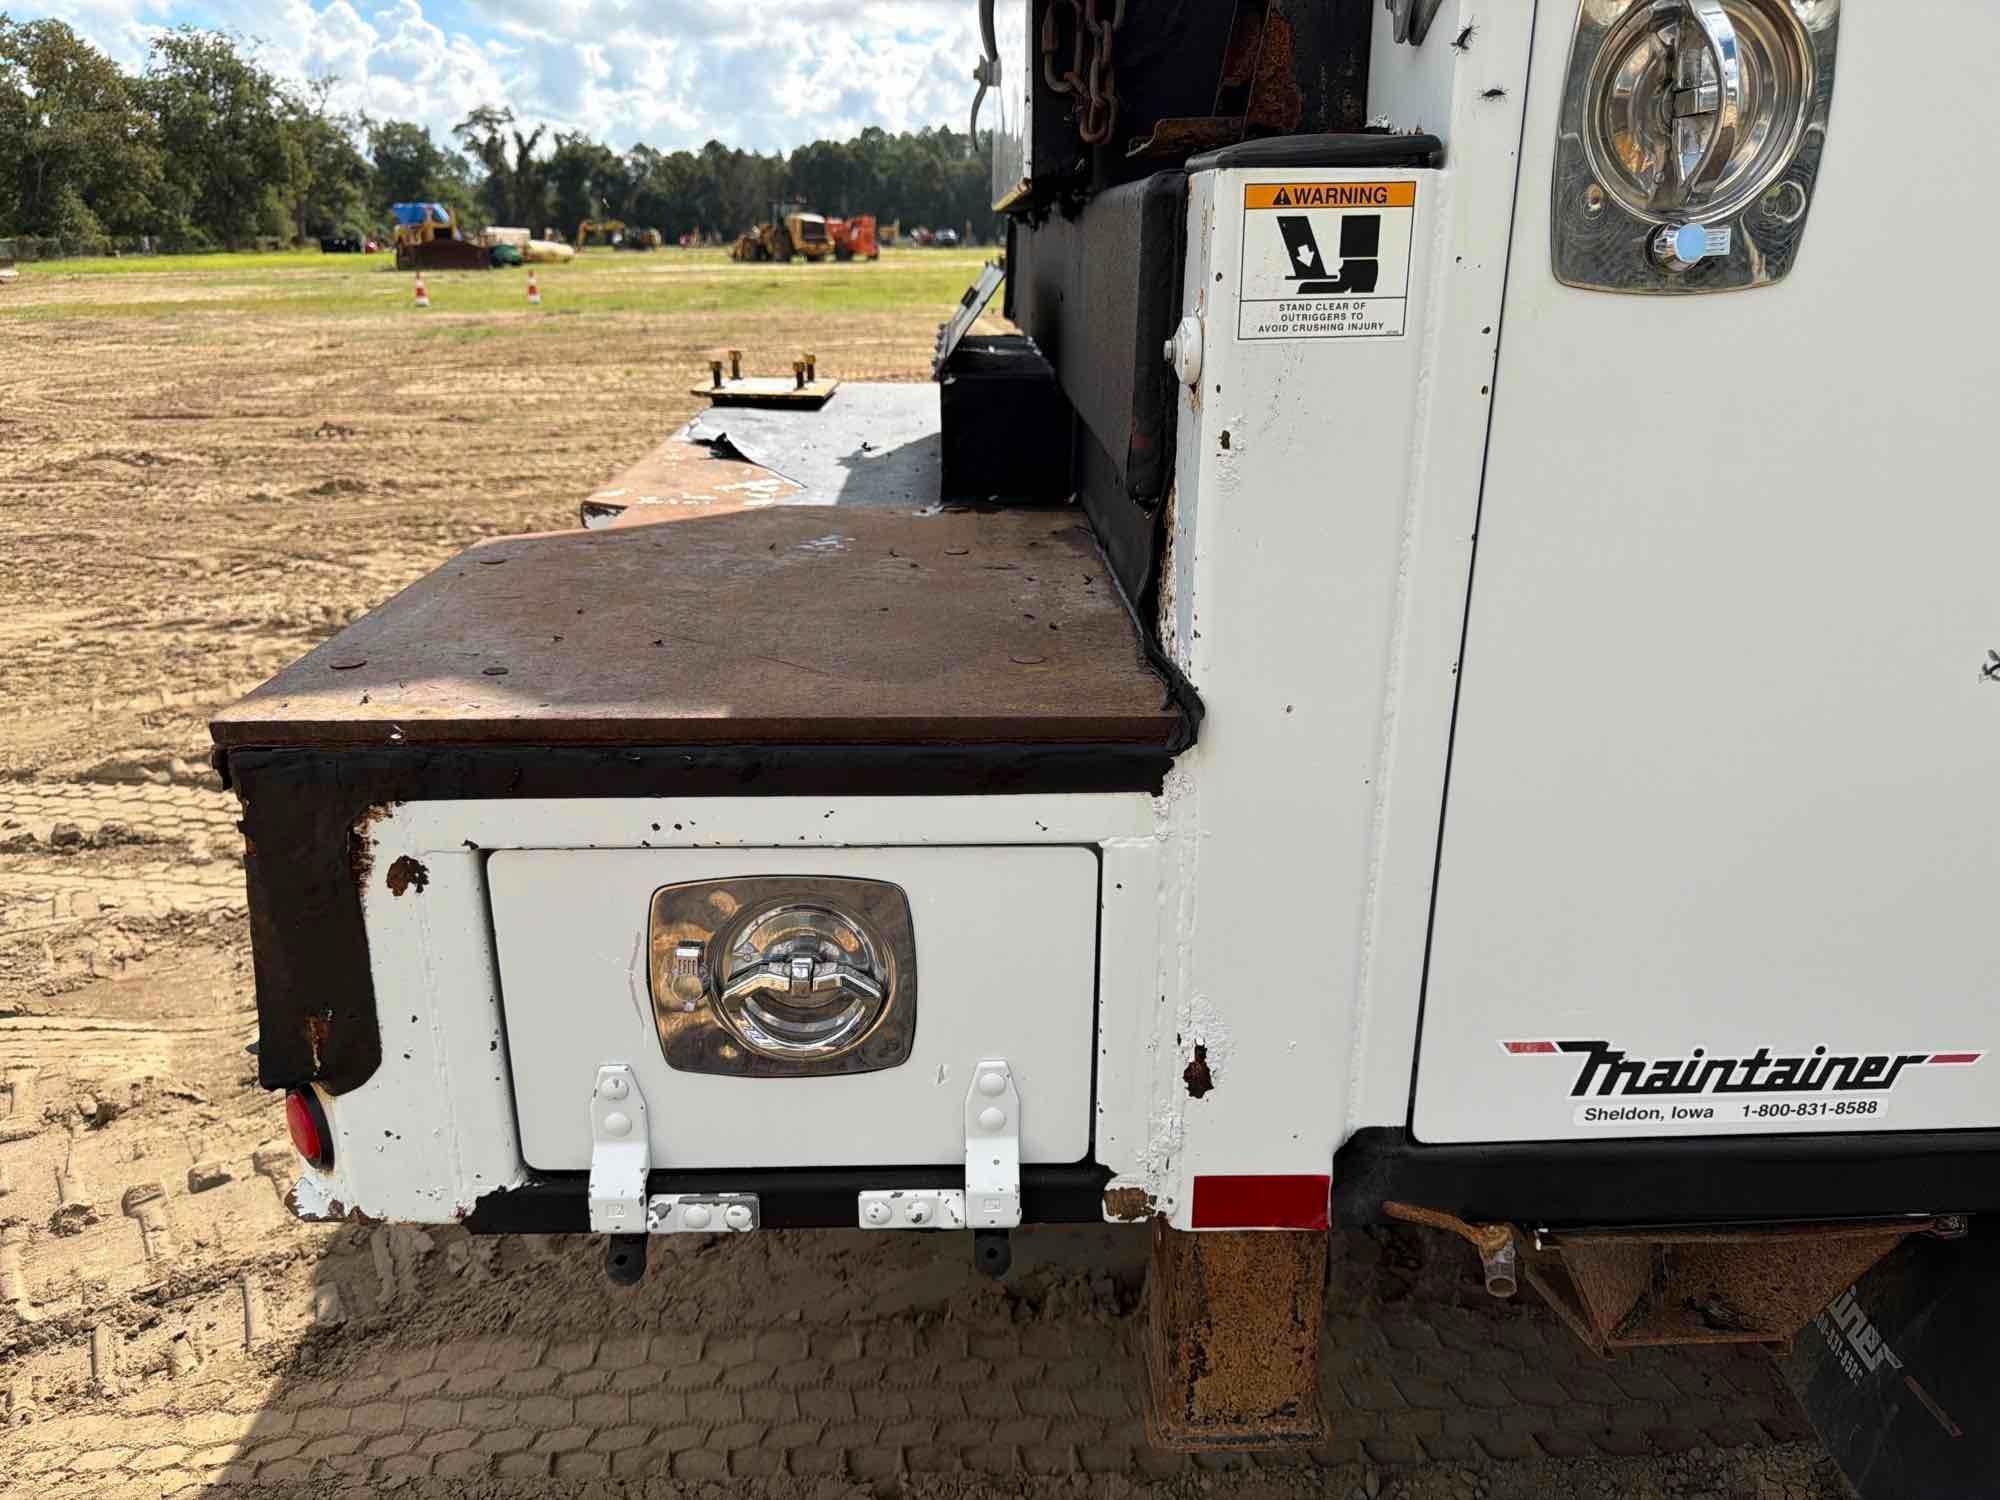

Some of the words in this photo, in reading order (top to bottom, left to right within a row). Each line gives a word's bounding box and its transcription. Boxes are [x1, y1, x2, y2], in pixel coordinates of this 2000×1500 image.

[1293, 187, 1388, 205] WARNING
[1279, 303, 1312, 312] STAND
[1315, 302, 1349, 311] CLEAR
[1353, 302, 1367, 310] OF
[1280, 312, 1347, 322] OUTRIGGERS
[1351, 312, 1364, 320] TO
[1258, 324, 1289, 333] AVOID
[1292, 323, 1344, 332] CRUSHING
[1347, 322, 1384, 331] INJURY
[1555, 1040, 1931, 1097] Maintainer
[1583, 1106, 1665, 1121] Sheldon,
[1671, 1106, 1715, 1119] Iowa
[1741, 1100, 1878, 1119] 1-800-831-8588
